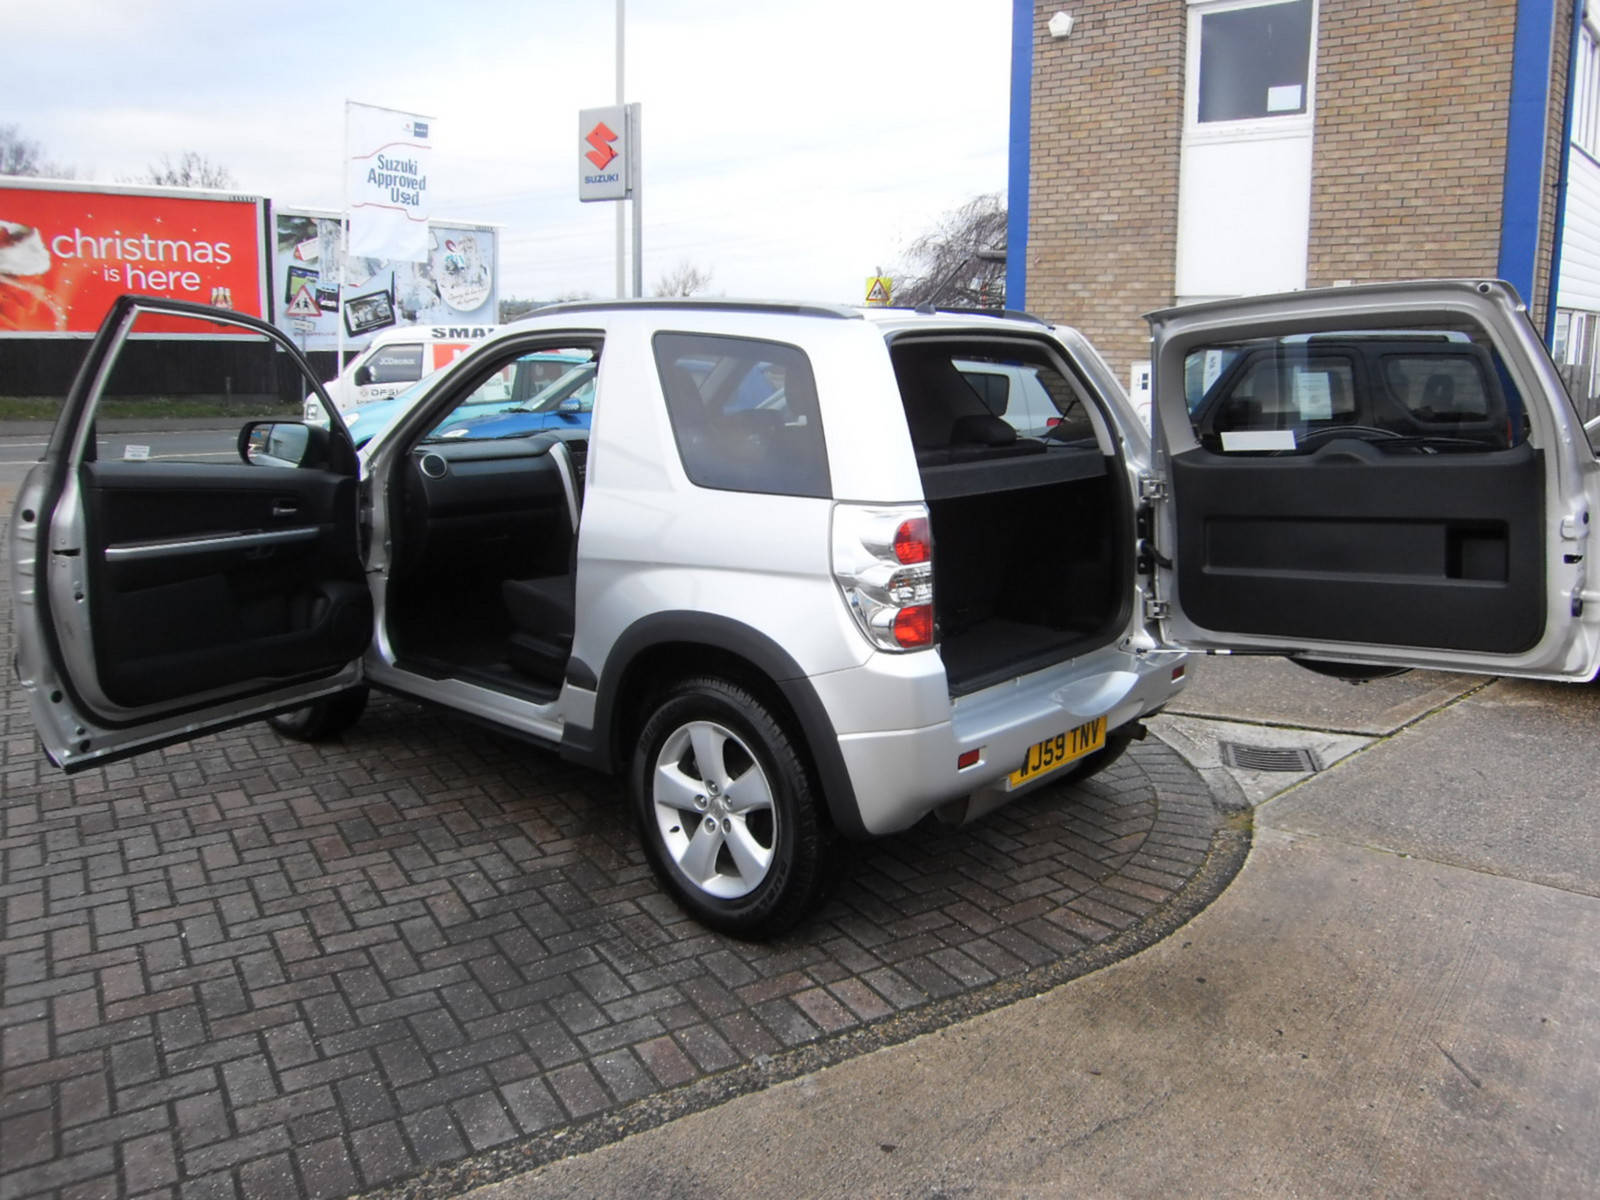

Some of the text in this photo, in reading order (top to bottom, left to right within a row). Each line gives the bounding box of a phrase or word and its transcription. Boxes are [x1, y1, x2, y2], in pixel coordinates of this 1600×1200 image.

[377, 154, 418, 175] Suzuki
[367, 168, 426, 191] Approved
[584, 174, 619, 184] SUZUKI
[391, 187, 420, 206] Used
[52, 228, 232, 264] christmas
[103, 264, 201, 291] is here
[1070, 717, 1101, 754] TNV
